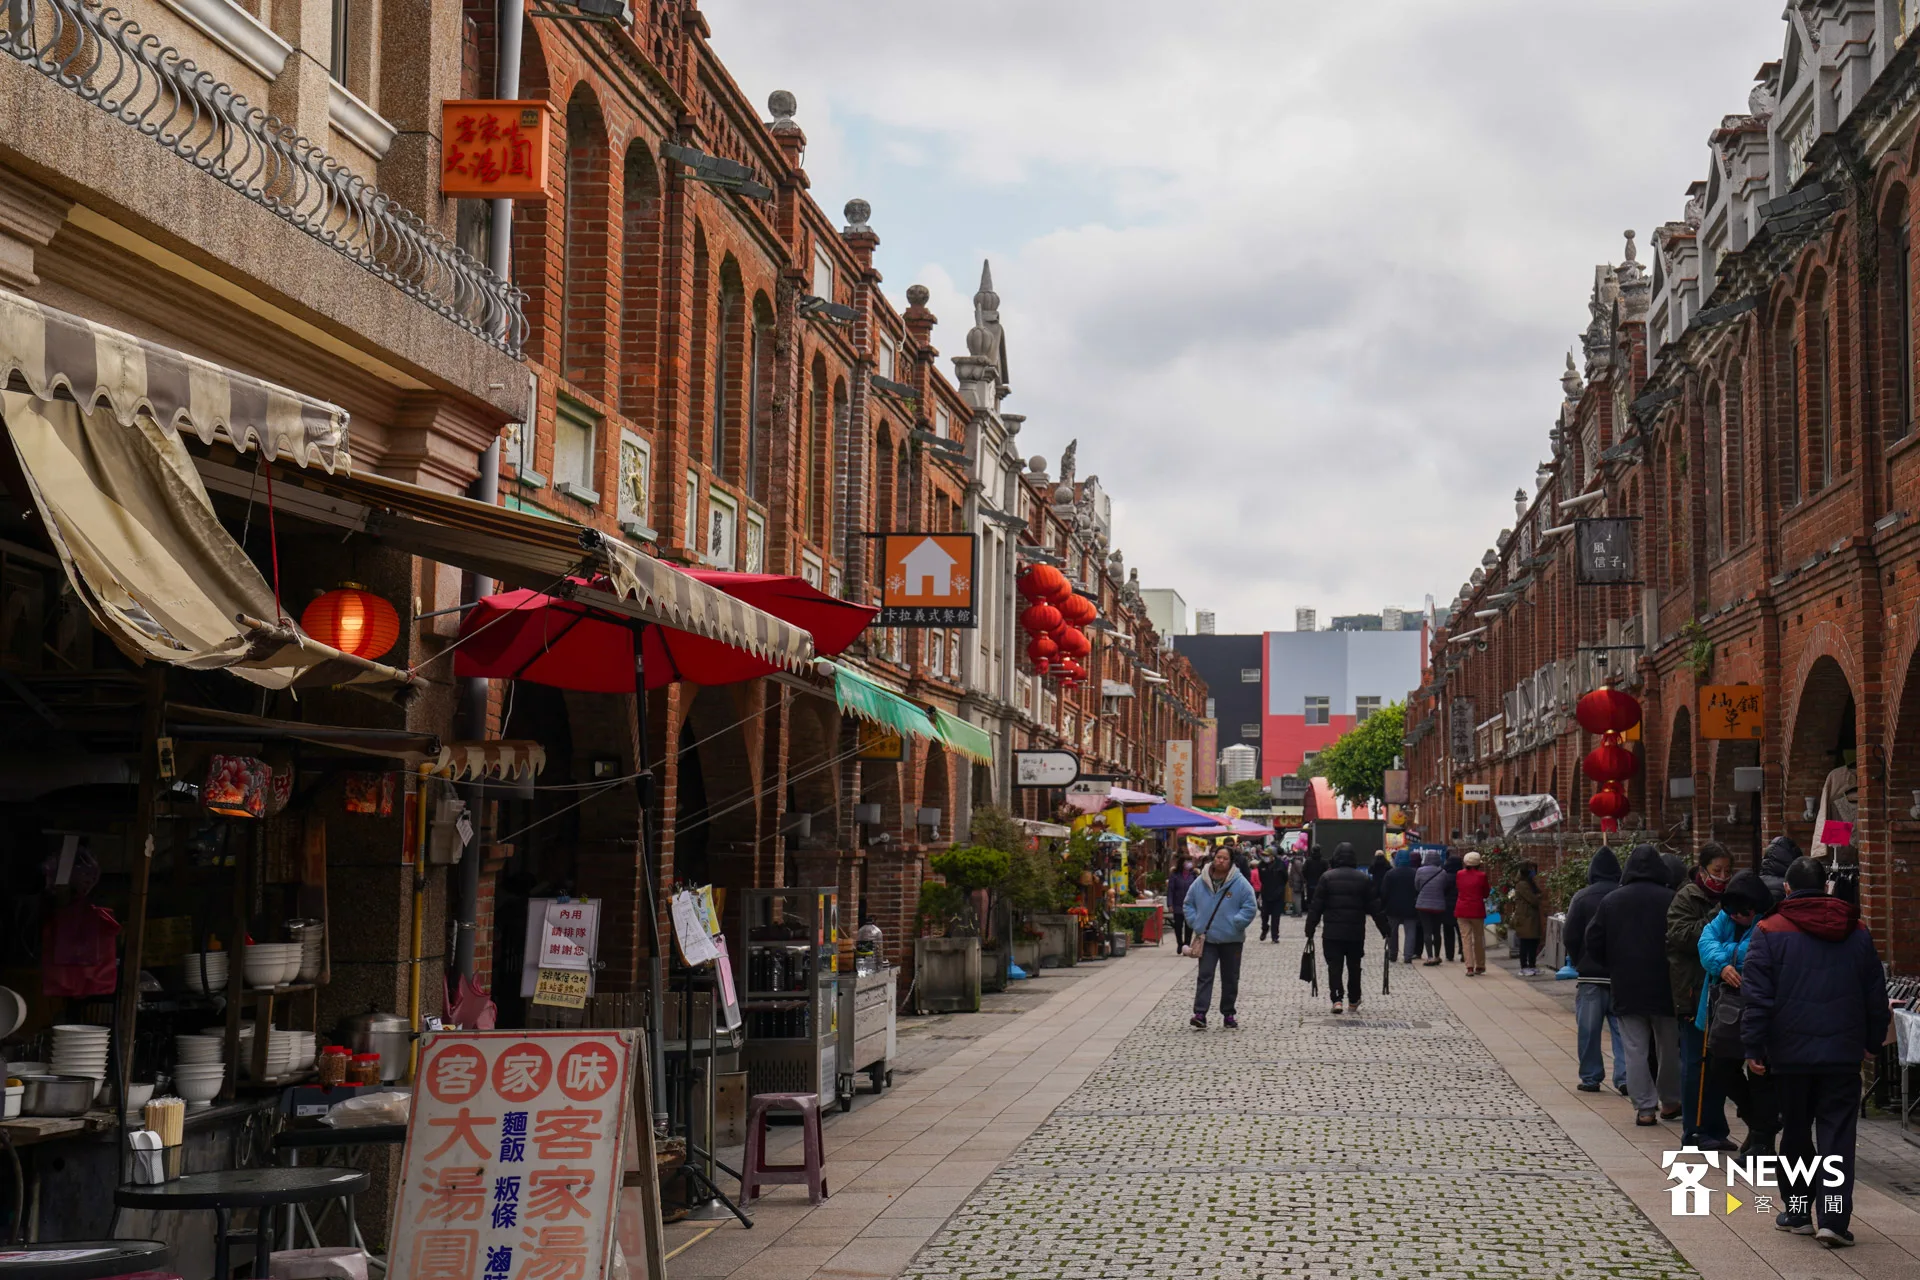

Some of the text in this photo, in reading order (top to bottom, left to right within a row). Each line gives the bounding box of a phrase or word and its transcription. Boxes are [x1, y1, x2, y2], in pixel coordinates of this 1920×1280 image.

[446, 139, 532, 183] 大湯圓
[885, 608, 970, 623] 卡拉義式餐館
[552, 926, 586, 938] 請排隊
[560, 909, 582, 919] 內用
[549, 944, 584, 956] 謝謝您
[436, 1052, 608, 1094] 客家味
[500, 1111, 528, 1163] 麵飯
[408, 1107, 497, 1280] 大湯圓
[491, 1176, 521, 1229] 粄條
[514, 1105, 603, 1280] 客家湯
